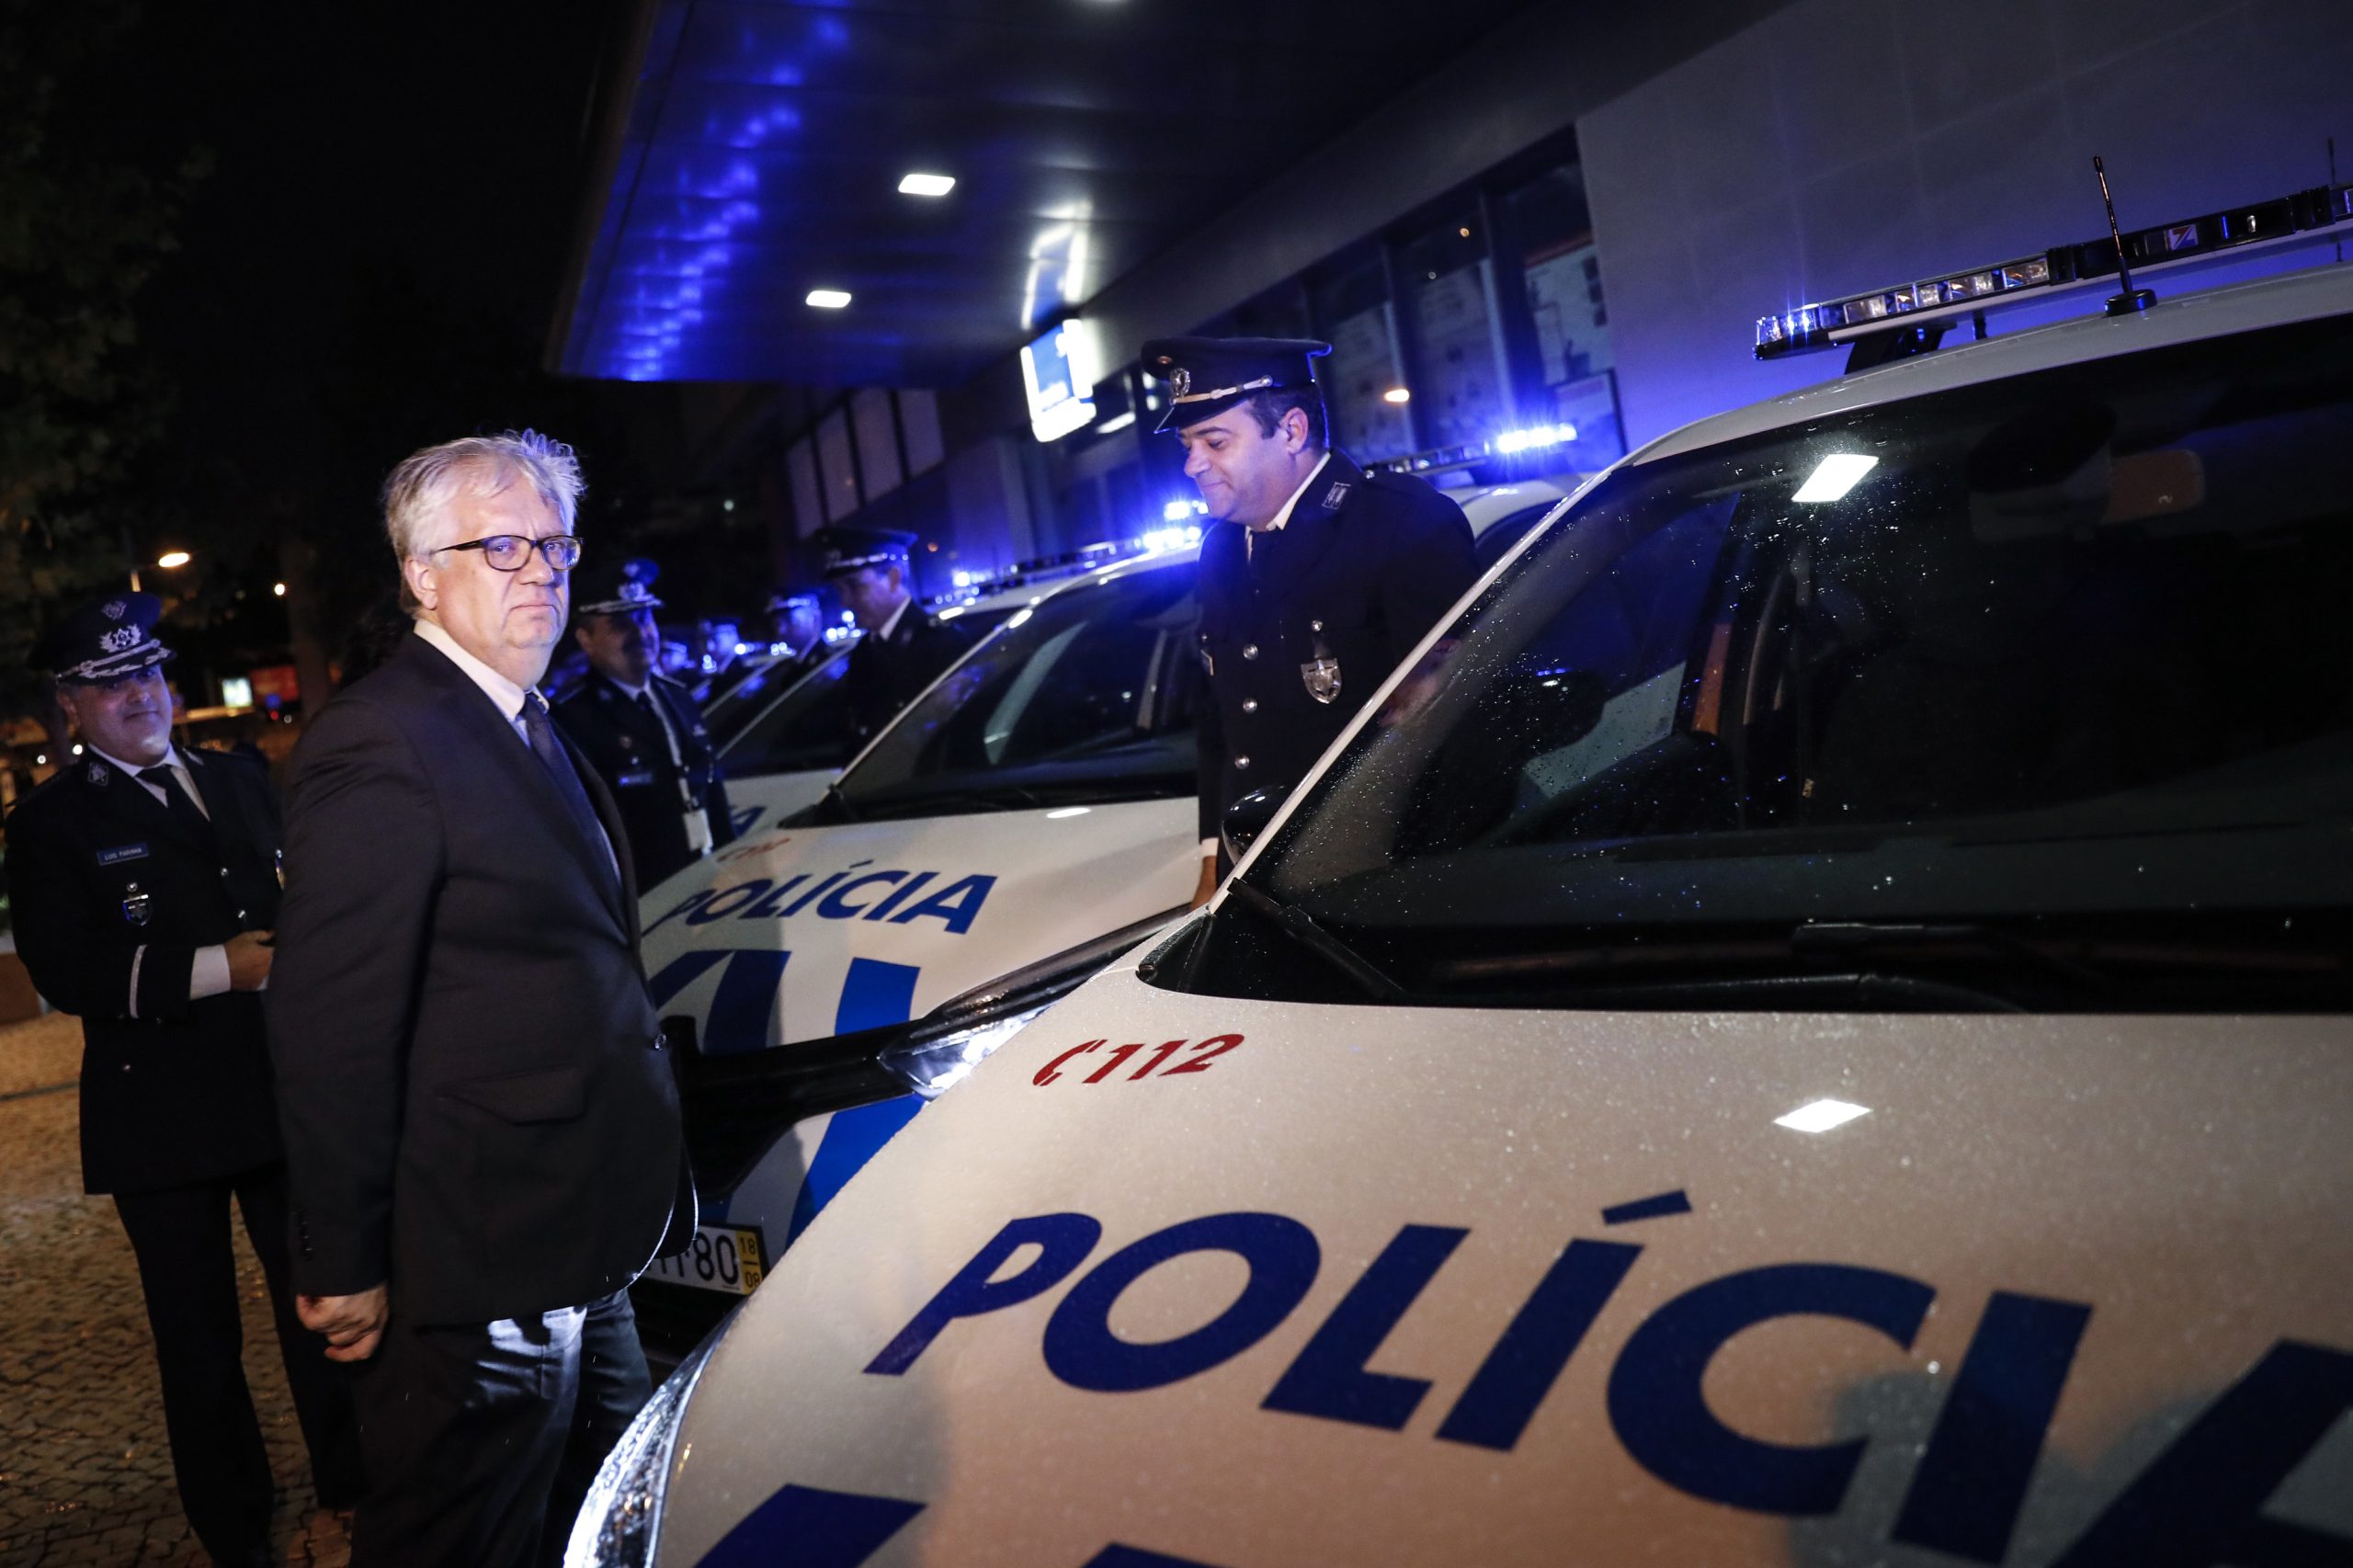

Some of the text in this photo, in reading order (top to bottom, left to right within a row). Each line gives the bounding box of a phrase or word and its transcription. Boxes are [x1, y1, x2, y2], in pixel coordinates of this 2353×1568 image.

[640, 859, 998, 936] POLÍCIA
[1082, 1033, 1245, 1084] 112
[739, 1236, 756, 1255] 18
